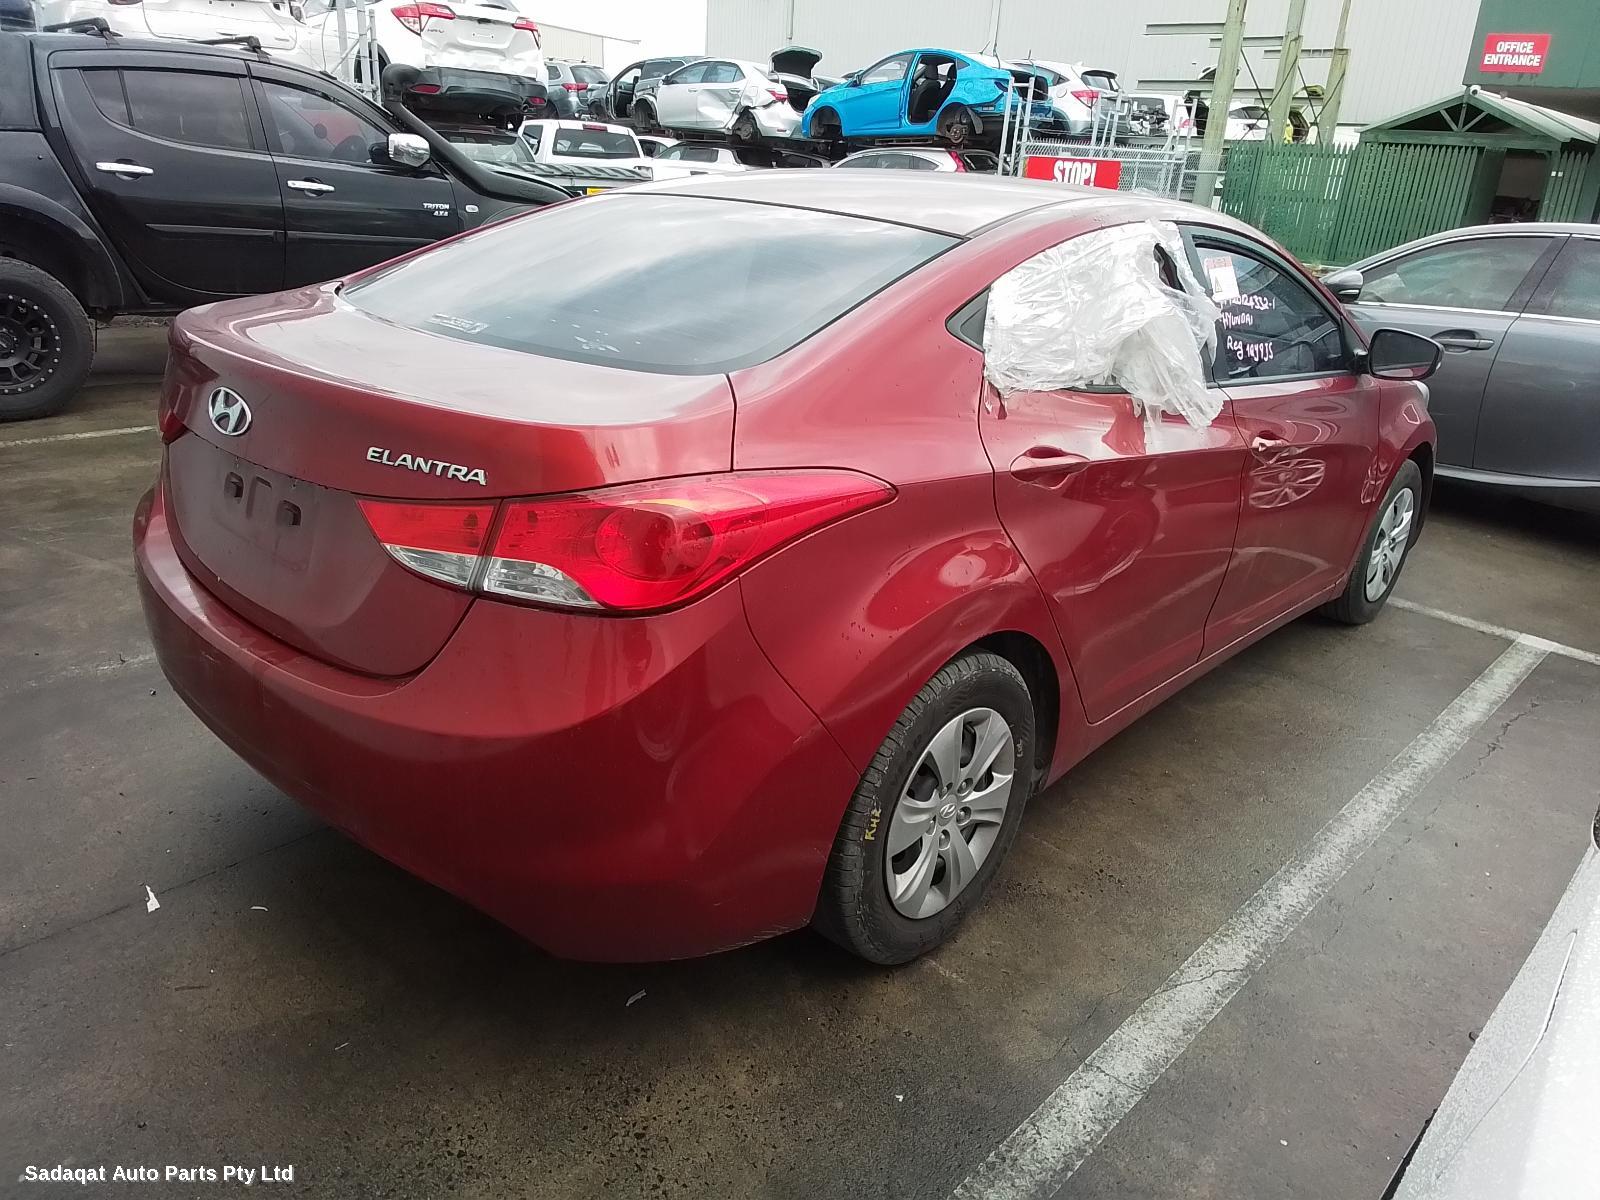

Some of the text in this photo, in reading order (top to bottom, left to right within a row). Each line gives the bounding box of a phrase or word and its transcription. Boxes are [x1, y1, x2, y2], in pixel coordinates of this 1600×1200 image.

[1496, 41, 1534, 54] OFFICE
[1483, 53, 1541, 67] ENTRANCE
[1053, 160, 1097, 187] STOP!
[423, 202, 450, 210] TRITON
[1227, 335, 1244, 361] Reg
[366, 446, 488, 486] ELANTRA
